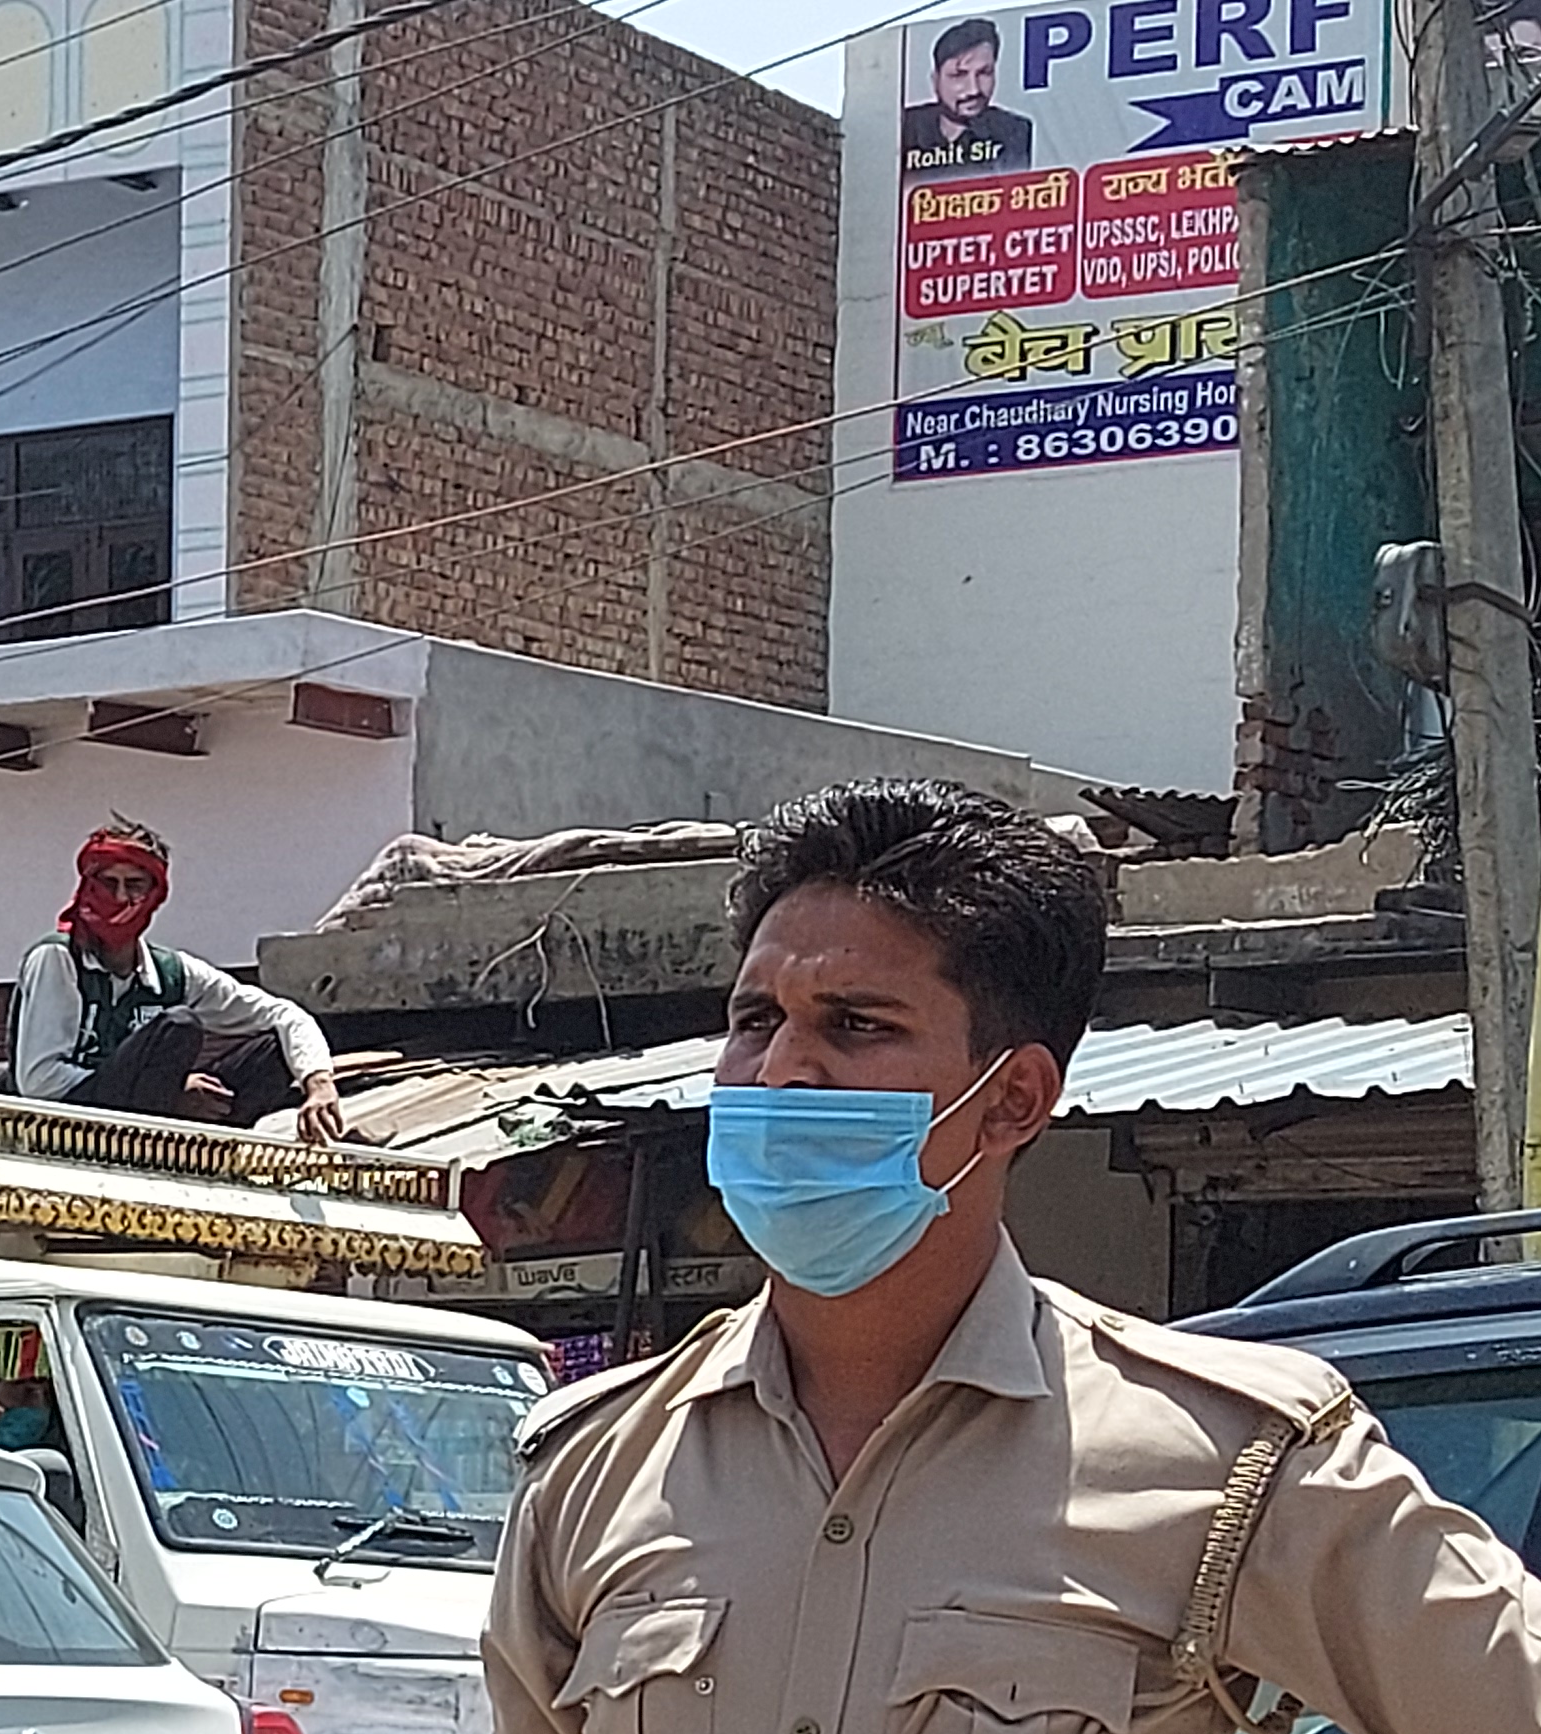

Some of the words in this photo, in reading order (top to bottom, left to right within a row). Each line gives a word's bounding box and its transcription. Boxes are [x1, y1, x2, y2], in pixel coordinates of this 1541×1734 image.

[1021, 0, 1351, 91] PERF
[1222, 64, 1365, 119] CAM
[906, 144, 964, 170] Rohit
[970, 140, 1004, 163] Sir
[911, 185, 1005, 225] शिक्षक
[1010, 171, 1071, 211] भर्ती
[1101, 167, 1171, 201] राज्य
[907, 233, 997, 270] UPTET,
[1004, 224, 1074, 259] CTET
[1084, 215, 1165, 250] UPSSSC,
[919, 265, 1059, 306] SUPERTET
[1083, 257, 1128, 288] VDO,
[962, 310, 1100, 382] बैच
[905, 410, 960, 439] Near
[965, 397, 1090, 431] Chaudhary
[1095, 386, 1189, 418] Nursing
